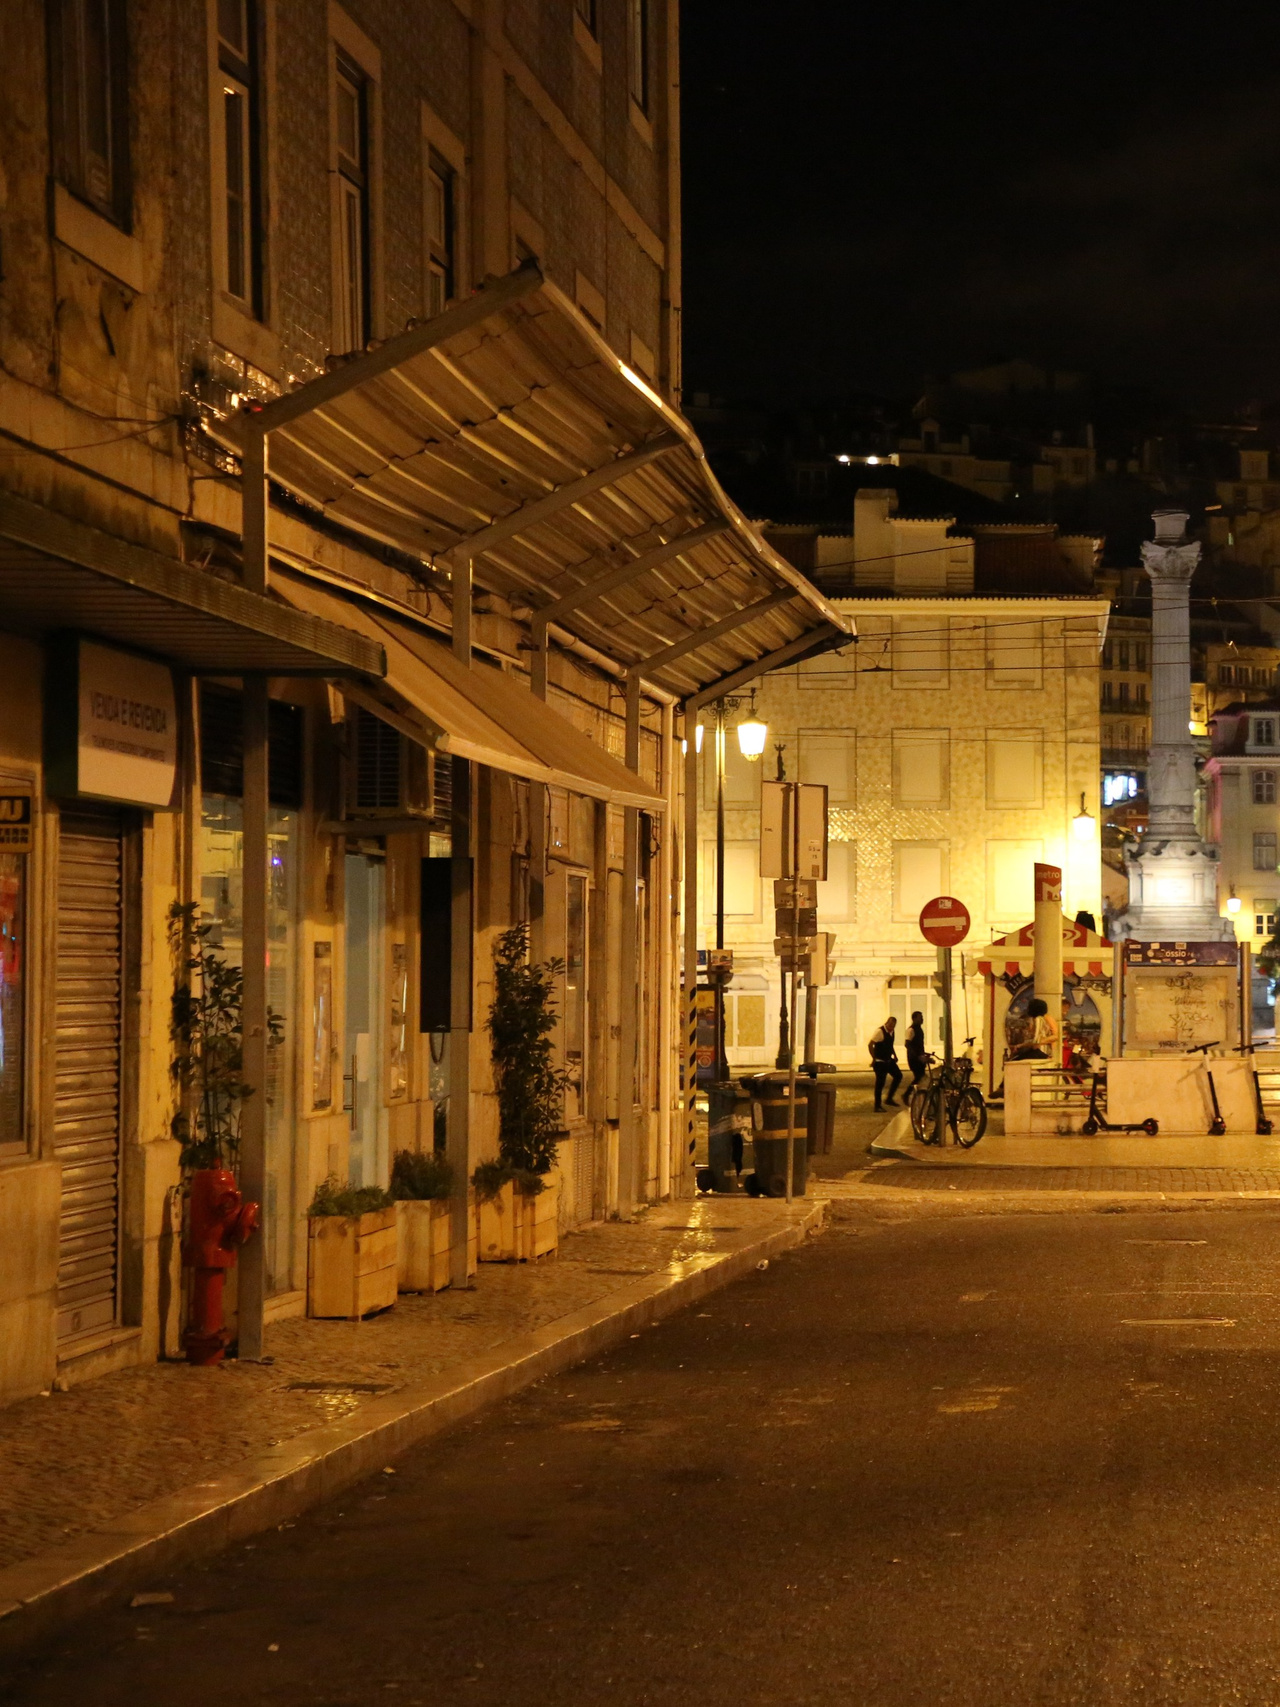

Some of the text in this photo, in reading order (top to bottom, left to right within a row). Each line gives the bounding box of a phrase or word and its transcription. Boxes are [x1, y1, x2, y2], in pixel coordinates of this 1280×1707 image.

[91, 689, 168, 735] VENDA E REVENDA
[1036, 870, 1060, 879] metro
